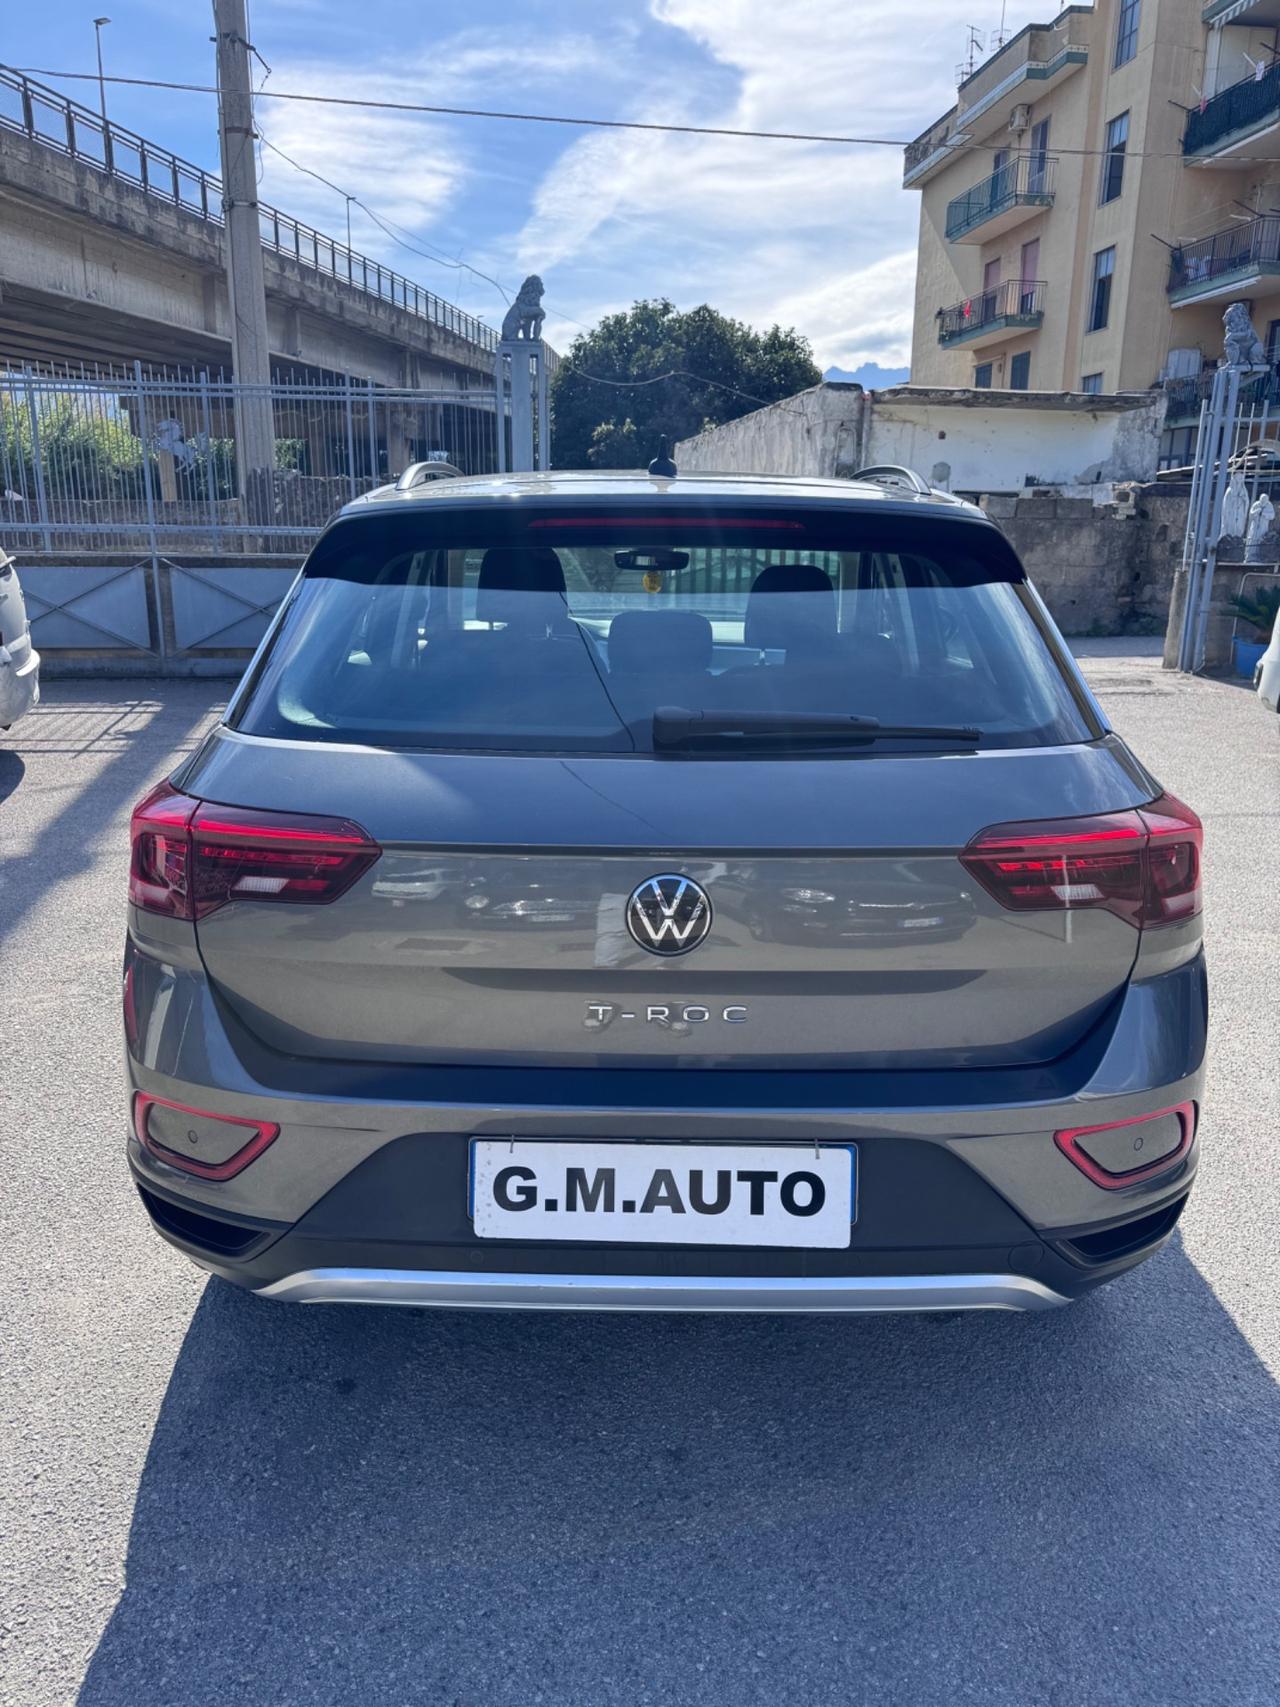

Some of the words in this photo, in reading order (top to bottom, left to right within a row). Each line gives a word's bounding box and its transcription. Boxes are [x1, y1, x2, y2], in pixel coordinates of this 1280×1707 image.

[630, 877, 707, 948] VW
[588, 1005, 748, 1023] T-ROC
[492, 1166, 826, 1217] G.M.AUTO
